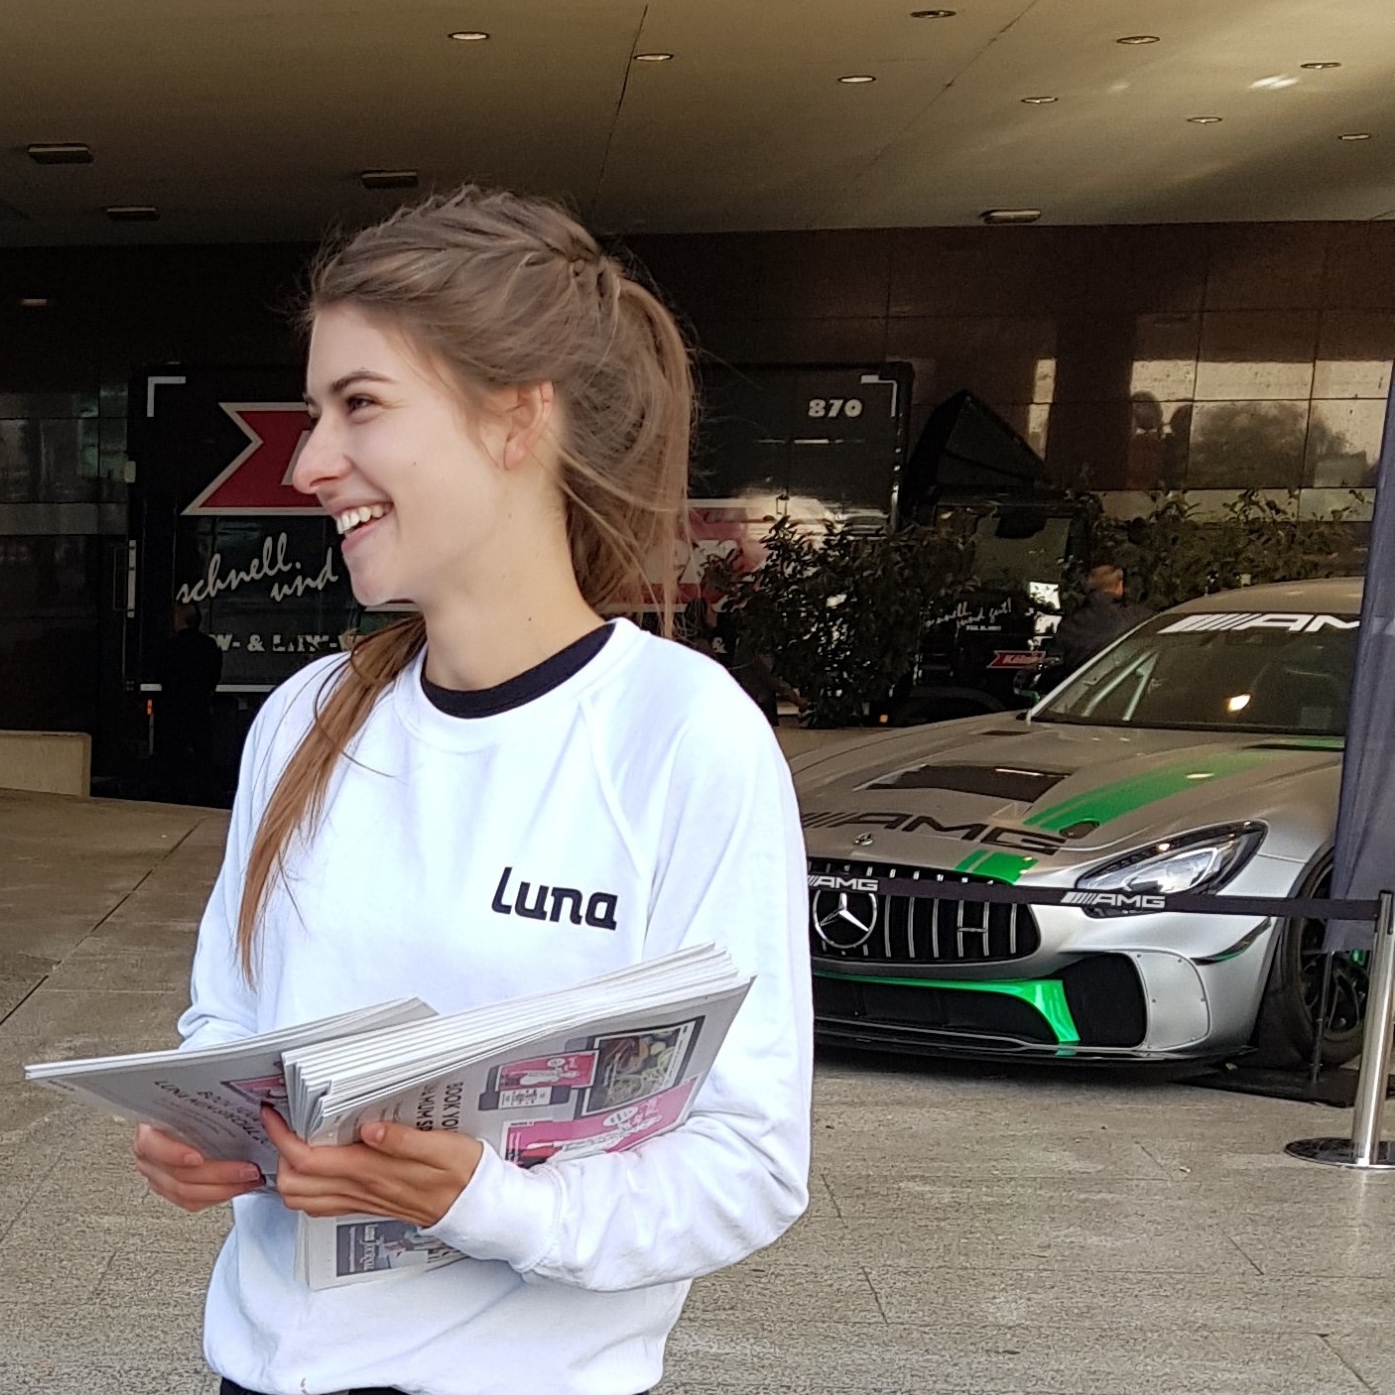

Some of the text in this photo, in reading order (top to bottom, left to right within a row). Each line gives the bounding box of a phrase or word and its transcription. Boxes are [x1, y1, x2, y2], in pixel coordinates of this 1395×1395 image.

[808, 399, 864, 418] 870
[270, 547, 339, 602] und
[826, 812, 1067, 856] AMG
[815, 875, 879, 892] AMG
[1091, 893, 1166, 909] AMG
